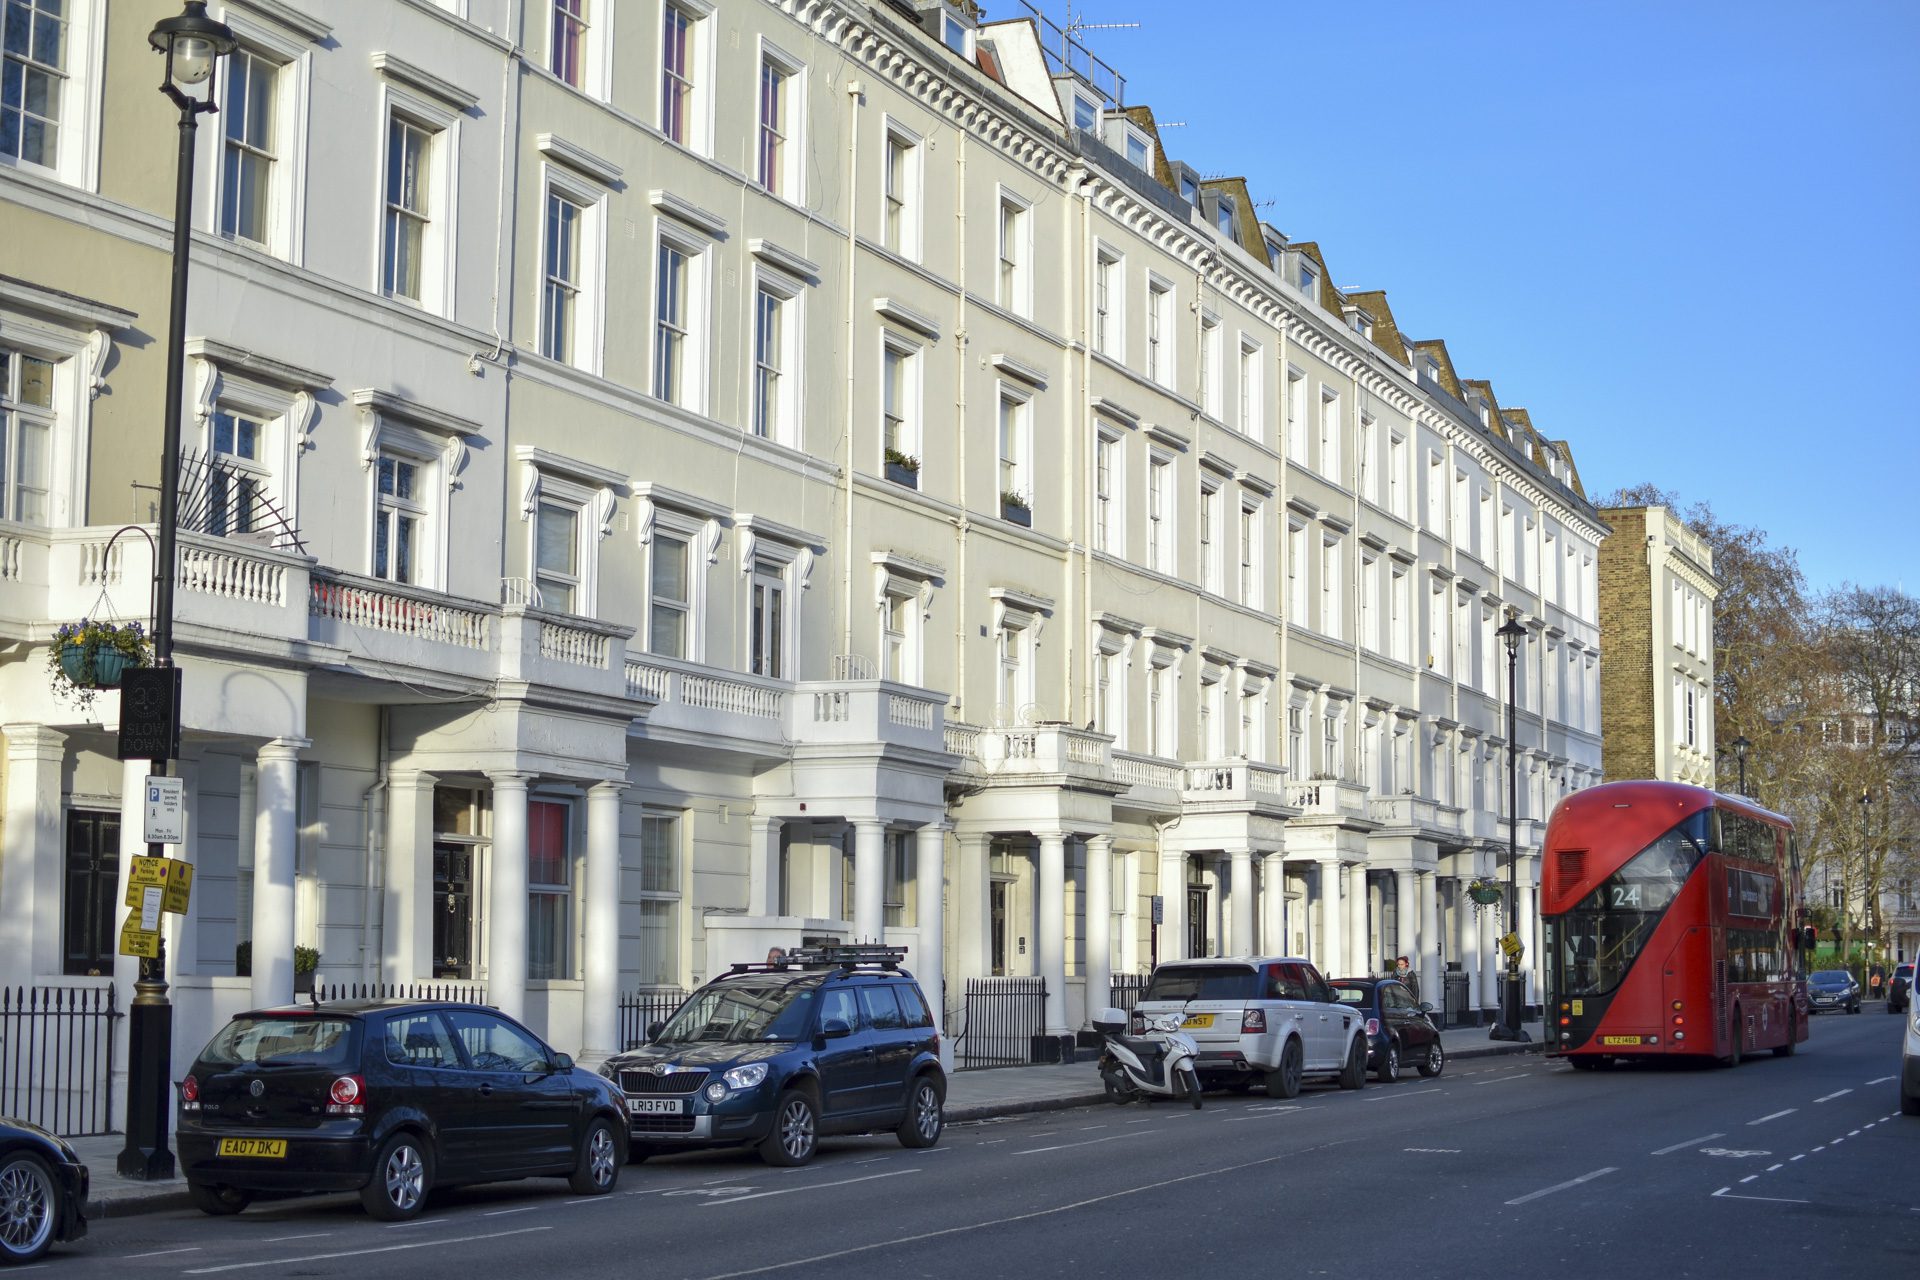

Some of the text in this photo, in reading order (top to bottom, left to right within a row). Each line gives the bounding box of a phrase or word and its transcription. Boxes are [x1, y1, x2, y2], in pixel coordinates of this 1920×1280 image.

[152, 789, 158, 800] P
[1613, 887, 1639, 906] 24
[632, 1101, 675, 1111] LR13 FVD
[224, 1140, 282, 1155] EA07 DKJ
